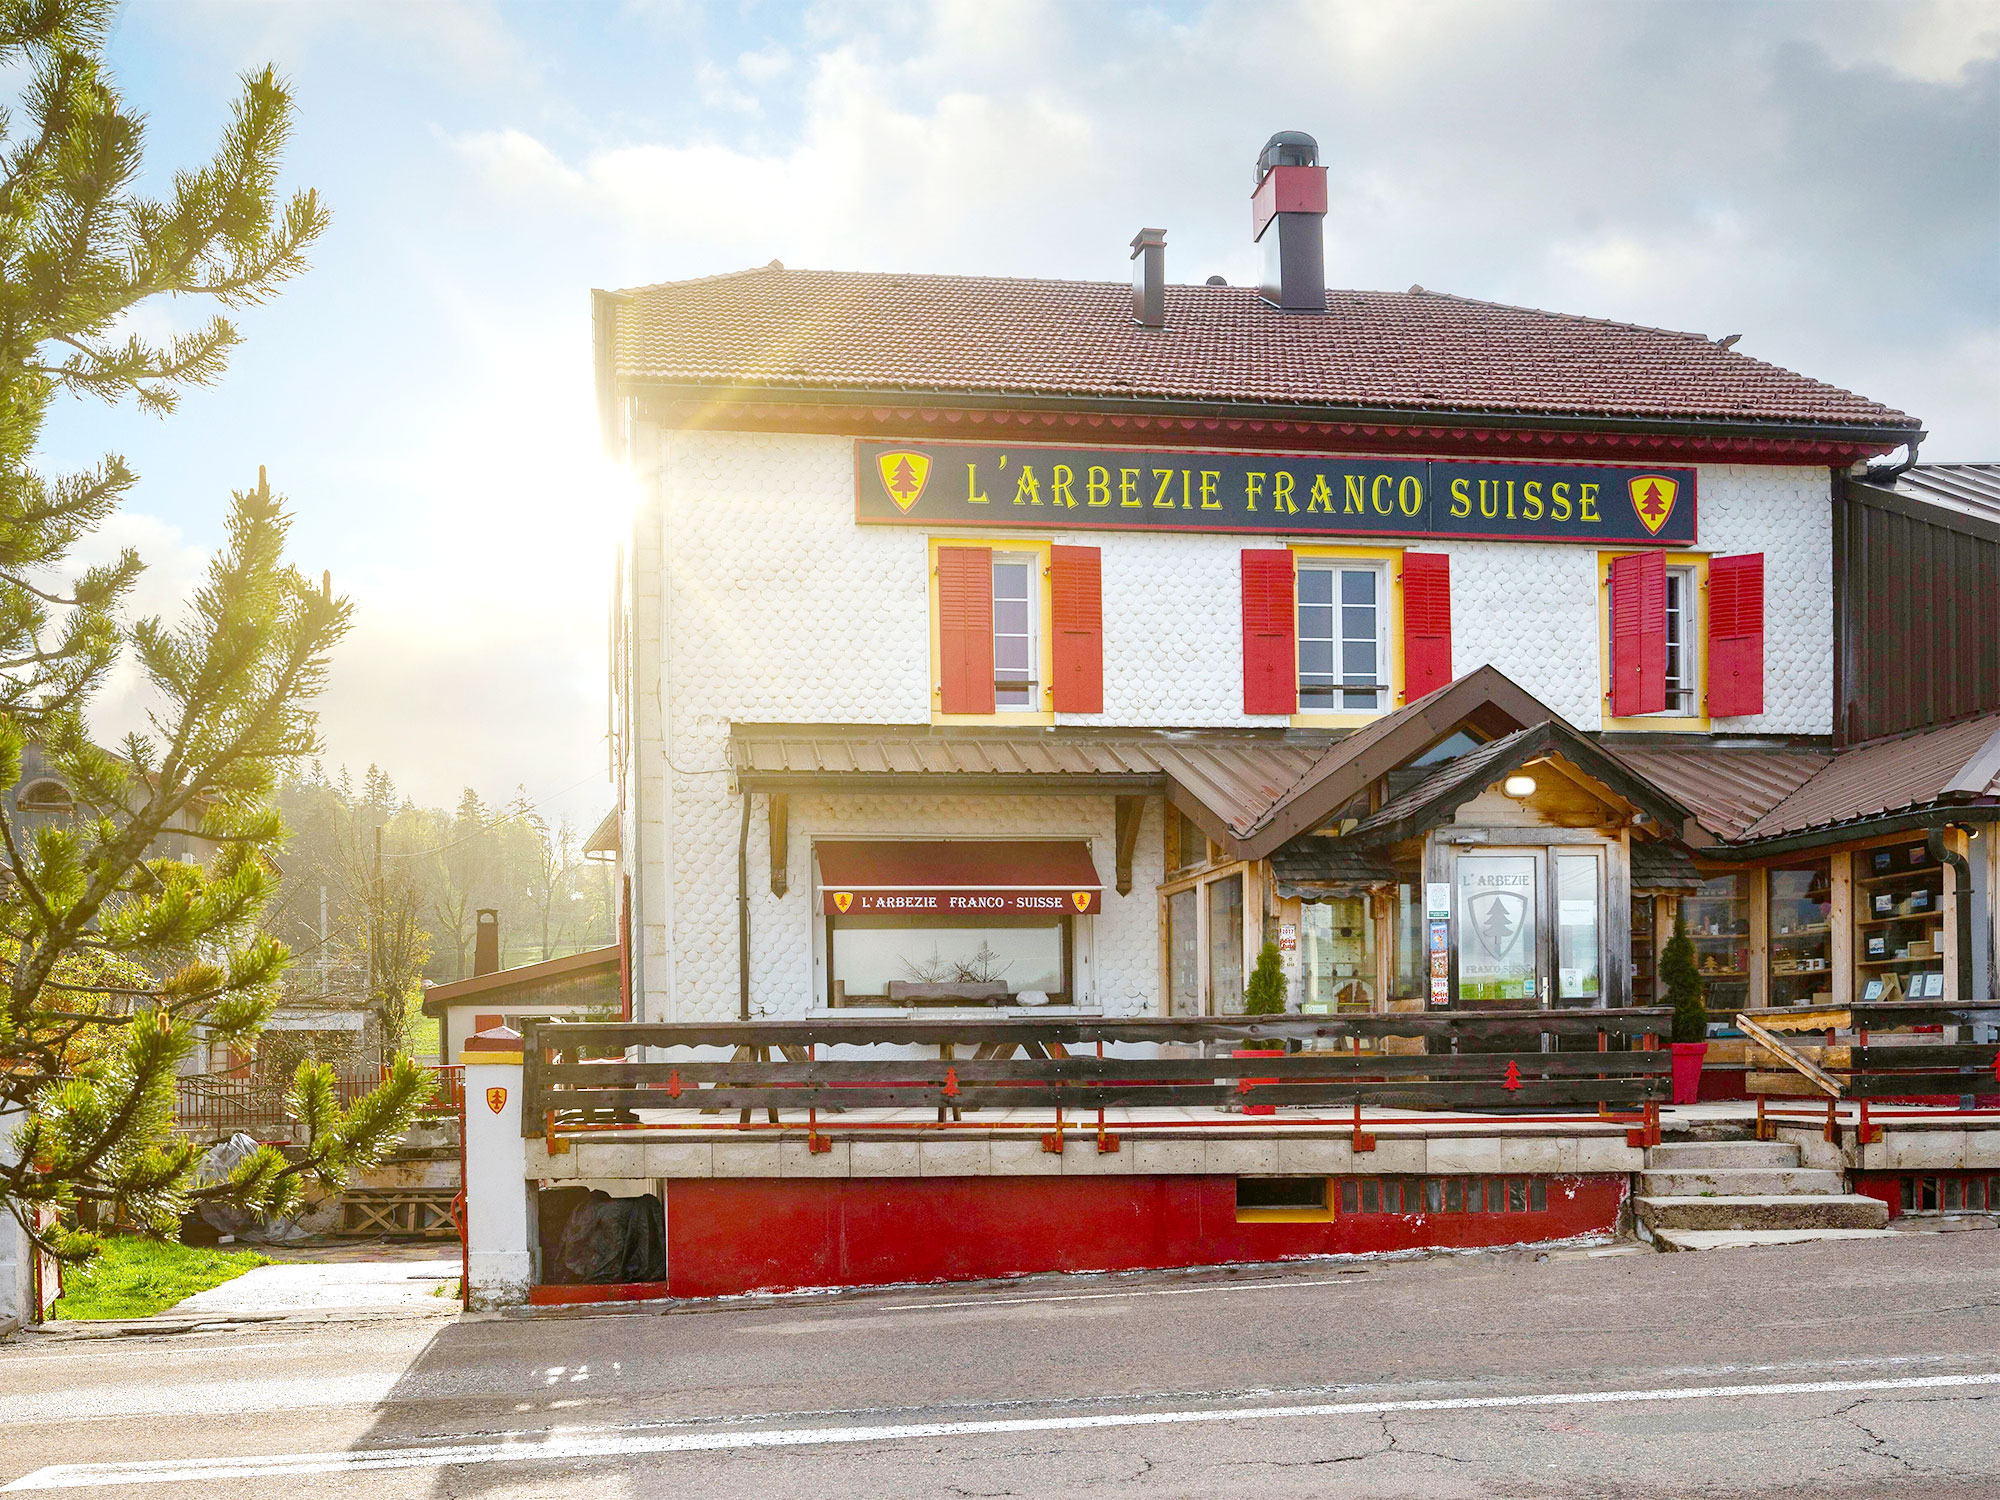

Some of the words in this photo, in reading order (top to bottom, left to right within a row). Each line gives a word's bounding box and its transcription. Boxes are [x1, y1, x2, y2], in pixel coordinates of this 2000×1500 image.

[966, 455, 1224, 511] L'ARBEZIE
[1244, 471, 1424, 517] FRANCO
[1450, 478, 1602, 523] SUISSE
[949, 896, 1005, 908] FRANCO
[1016, 896, 1064, 908] SUISSE
